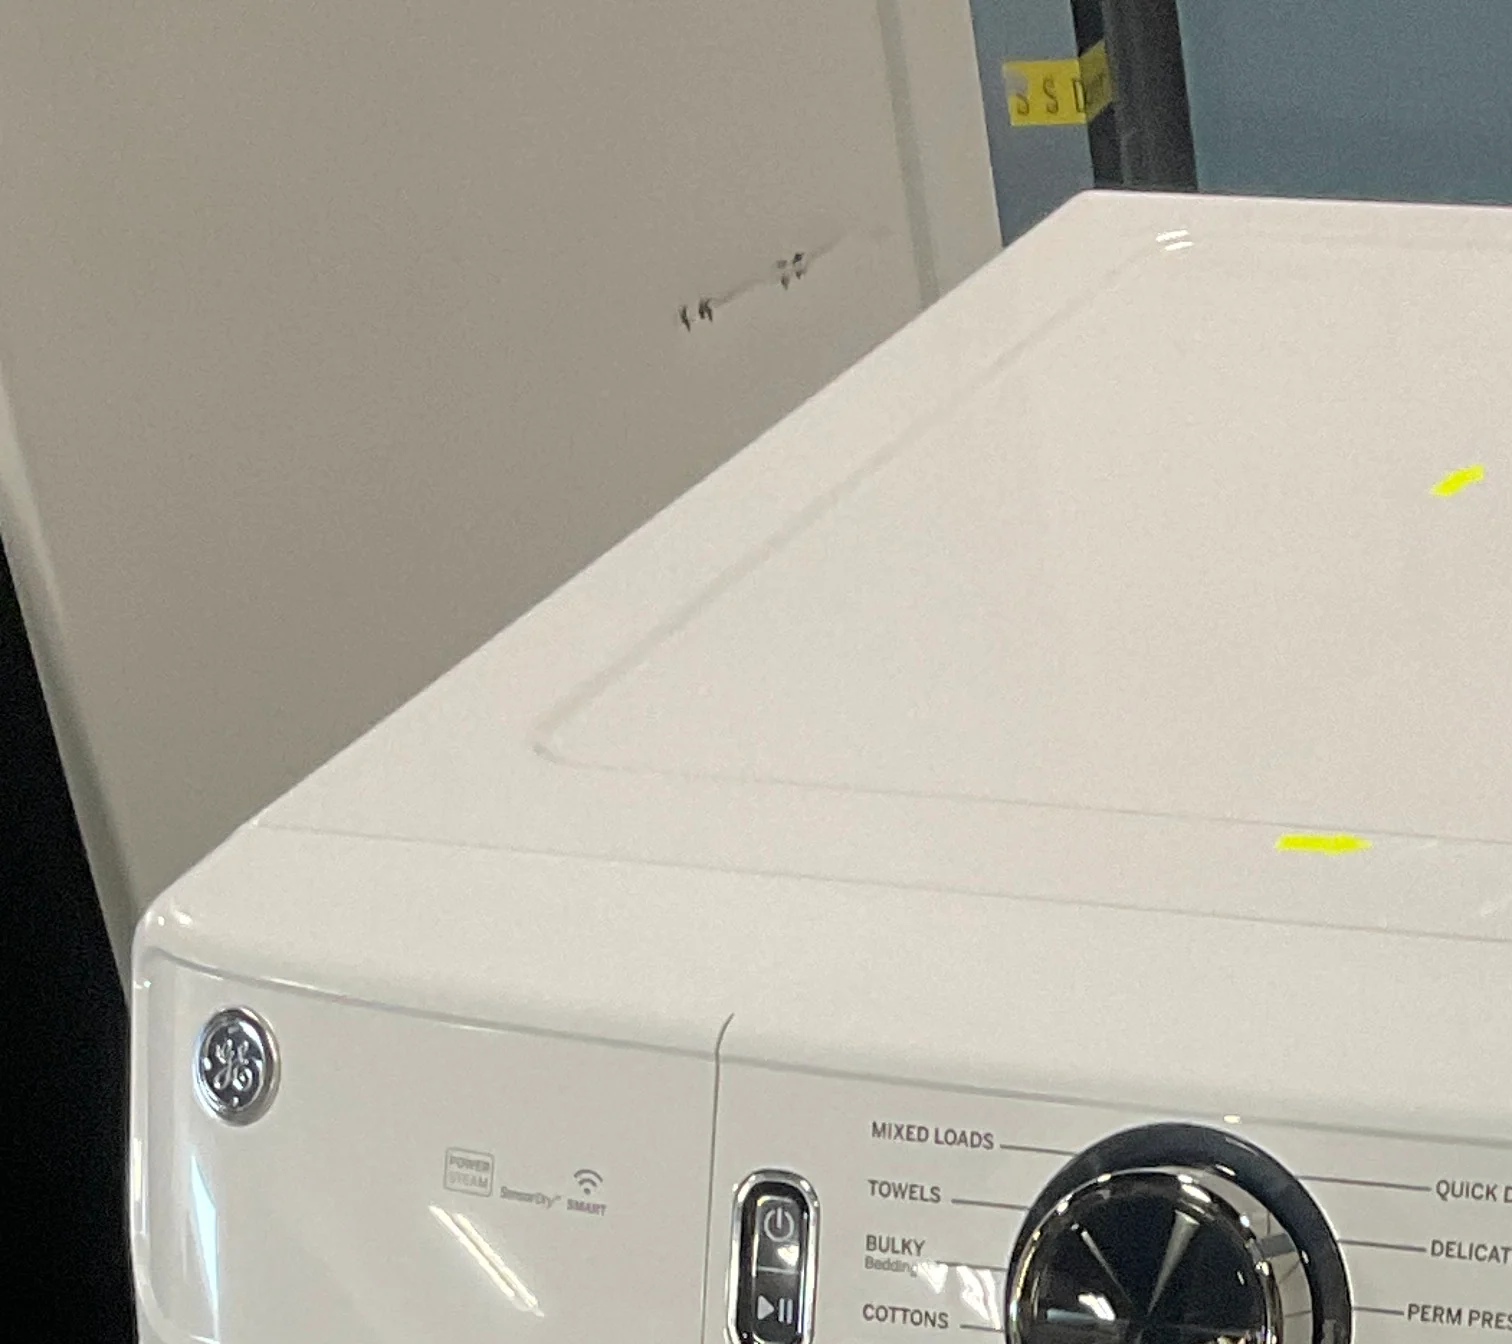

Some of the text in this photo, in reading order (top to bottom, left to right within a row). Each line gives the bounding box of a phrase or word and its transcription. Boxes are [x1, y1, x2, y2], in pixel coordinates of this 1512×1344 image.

[871, 1121, 995, 1151] MIXED LOADS
[867, 1179, 942, 1204] TOWELS
[1436, 1179, 1499, 1202] QUICK
[865, 1234, 926, 1257] BULKY
[864, 1254, 918, 1277] Bedding
[862, 1303, 950, 1330] COTTONS
[1407, 1303, 1463, 1326] PERM
